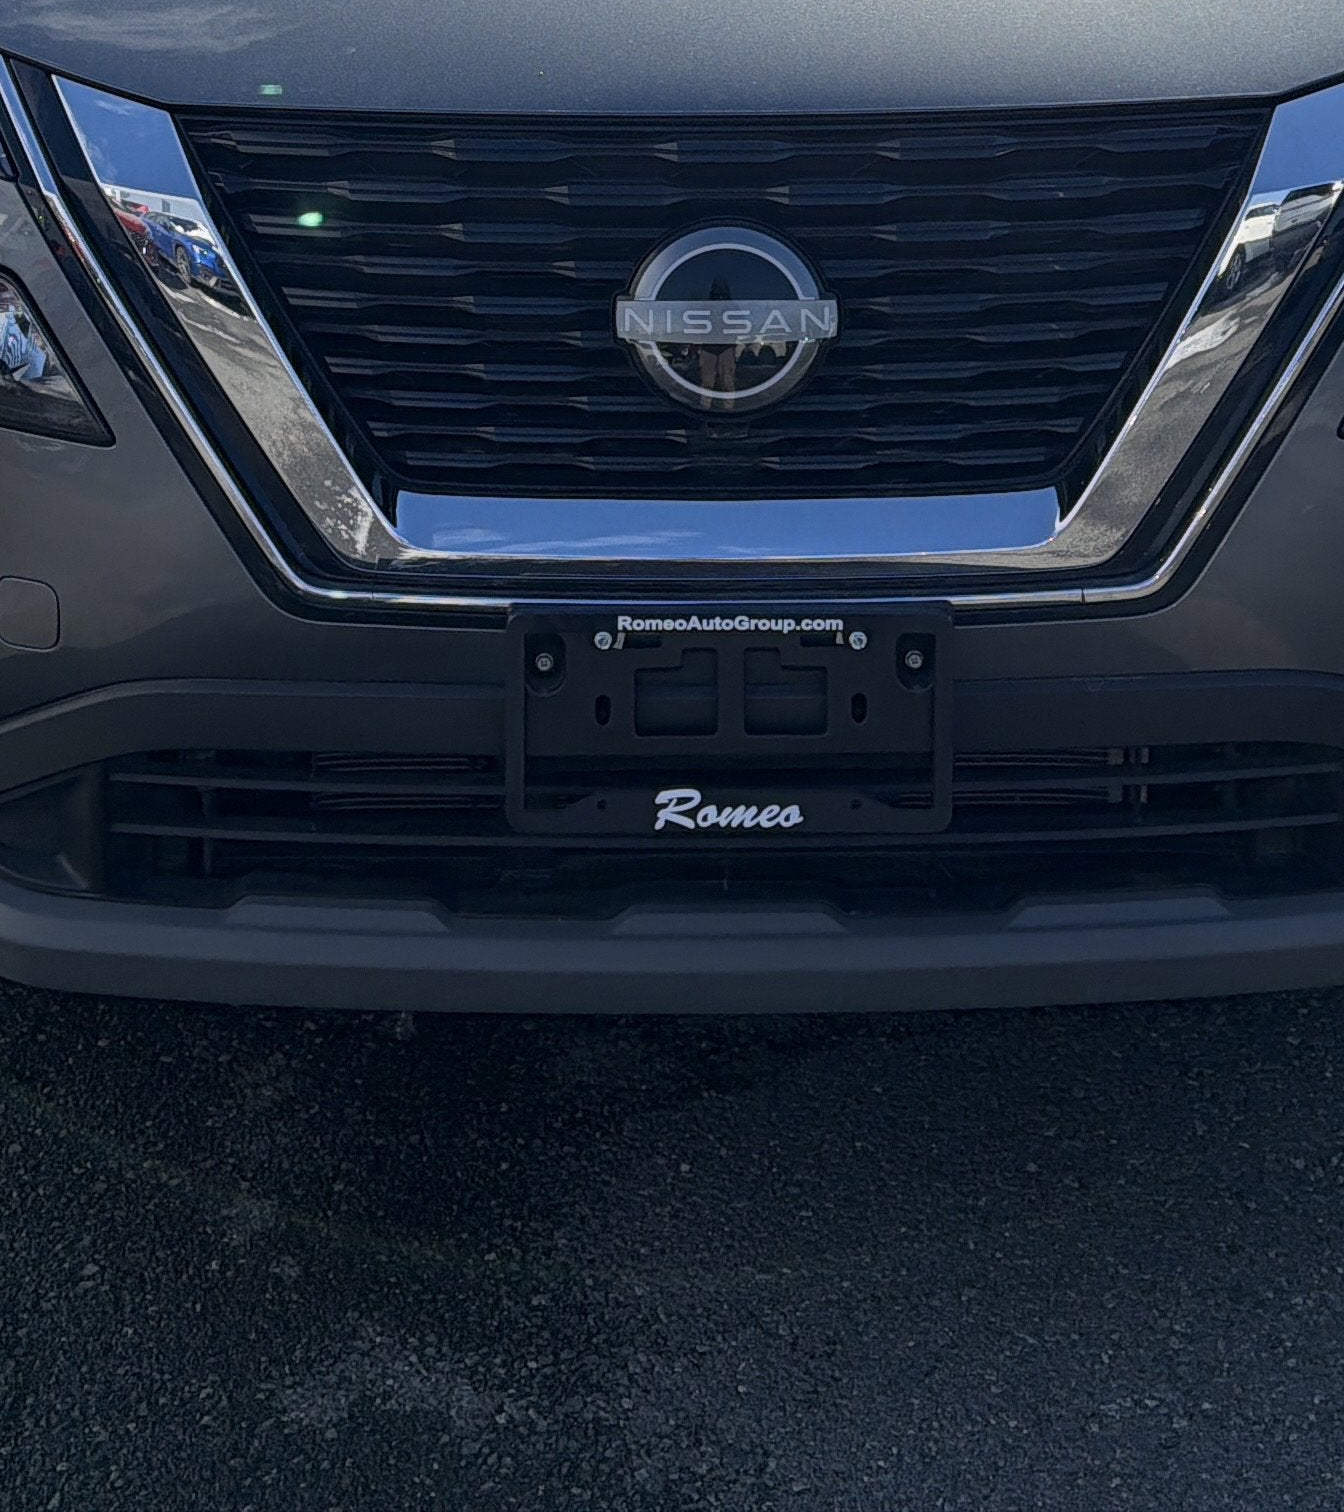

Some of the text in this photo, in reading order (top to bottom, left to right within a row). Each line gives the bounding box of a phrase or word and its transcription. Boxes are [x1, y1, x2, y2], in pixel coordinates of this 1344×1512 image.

[623, 306, 830, 335] NISSAN
[617, 615, 843, 634] RomeoAutoGroup.com
[654, 788, 804, 831] Romeo
